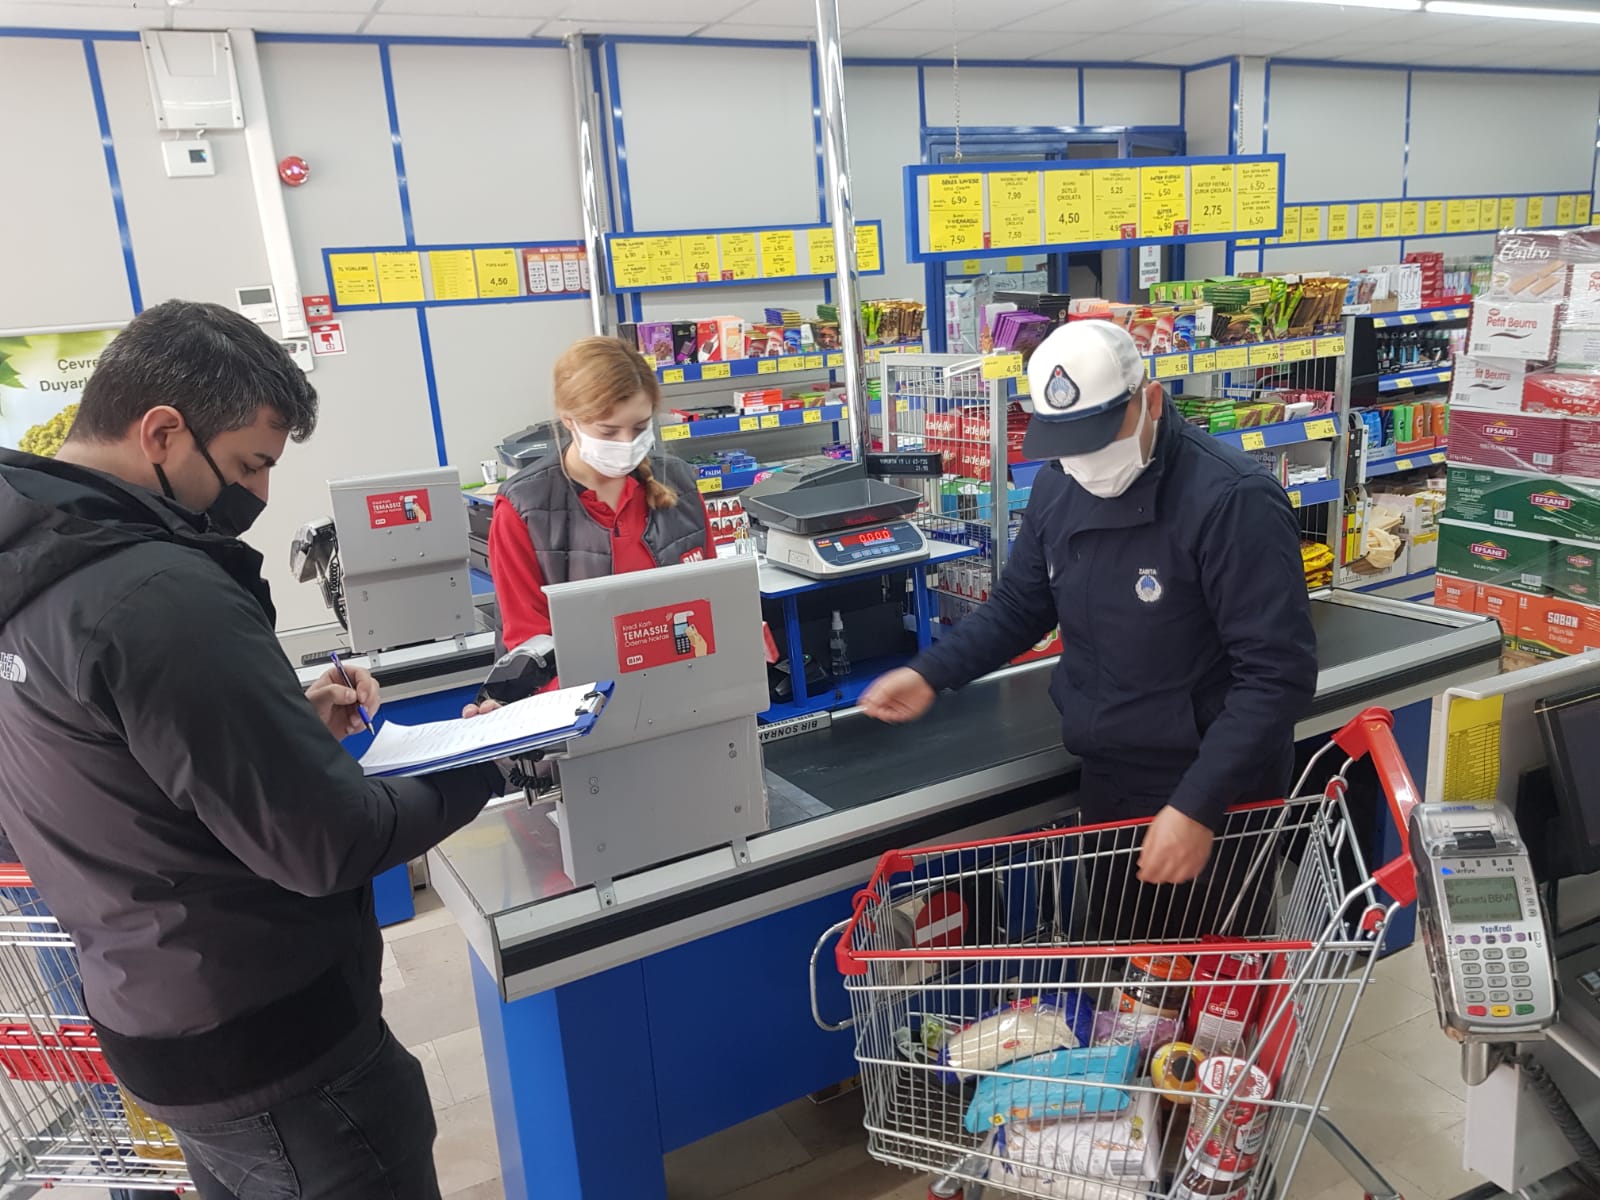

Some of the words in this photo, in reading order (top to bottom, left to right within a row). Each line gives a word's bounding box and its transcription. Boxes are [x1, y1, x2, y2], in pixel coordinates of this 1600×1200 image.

[1007, 191, 1022, 200] 7,90
[1203, 205, 1222, 216] 2,75
[1058, 212, 1080, 226] 4,50
[1008, 231, 1022, 240] 7,50
[490, 278, 508, 286] 4,50
[1487, 316, 1506, 327] Petit
[1508, 317, 1538, 329] Beurre
[1267, 352, 1278, 360] 7,50
[58, 358, 99, 373] Çevre
[1006, 364, 1020, 374] 4,50
[1486, 426, 1514, 436] EFSANE
[1535, 496, 1567, 506] EFSANE
[1474, 546, 1503, 557] EFSANE
[624, 624, 668, 640] TEMASSIZ
